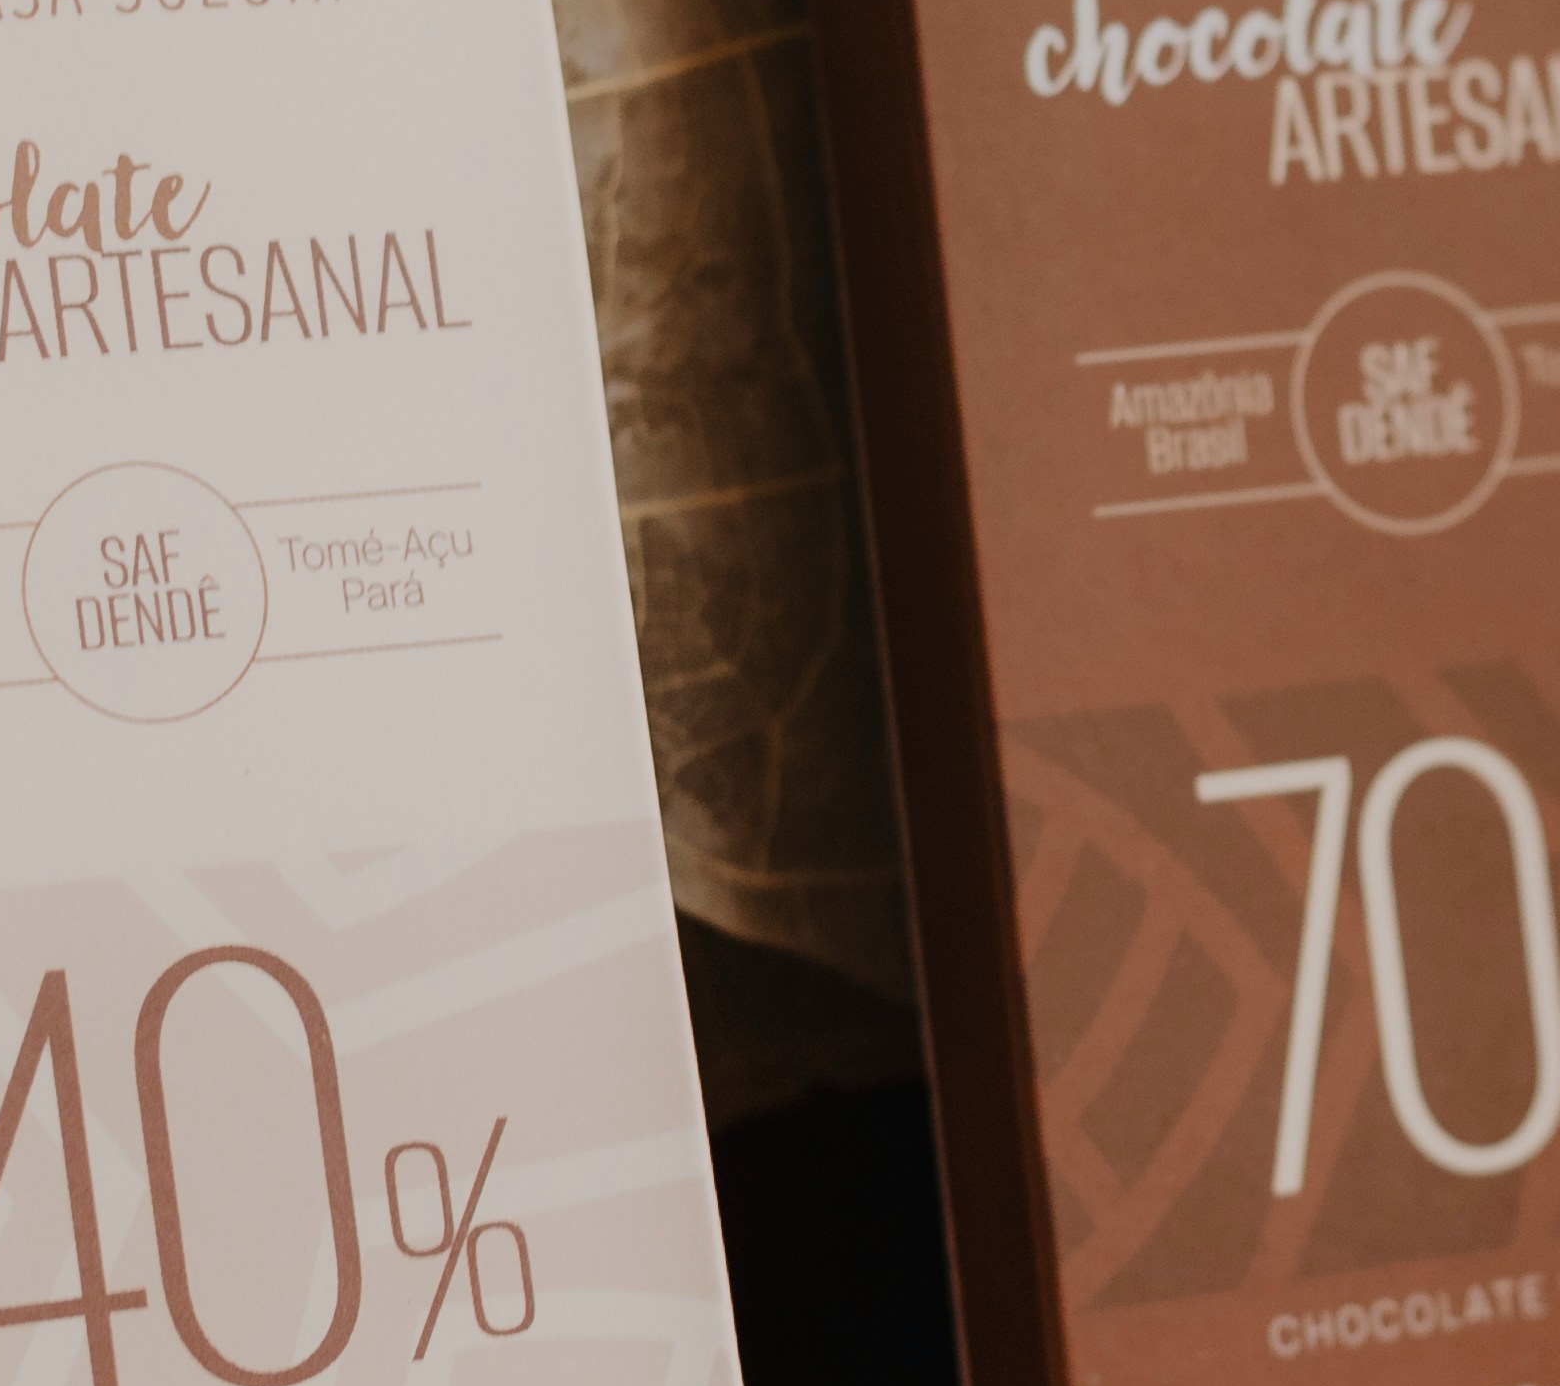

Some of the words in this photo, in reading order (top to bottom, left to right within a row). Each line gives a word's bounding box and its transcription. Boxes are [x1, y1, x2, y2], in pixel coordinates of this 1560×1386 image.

[1110, 370, 1272, 429] Amazônia
[1361, 337, 1438, 403] SAF
[1147, 420, 1248, 474] Brasil
[100, 529, 181, 589] SAF
[277, 524, 473, 574] Tomé-Açu
[75, 575, 226, 650] DENDÊ
[342, 570, 424, 612] Pará
[1269, 1273, 1544, 1359] CHOCOLATE
